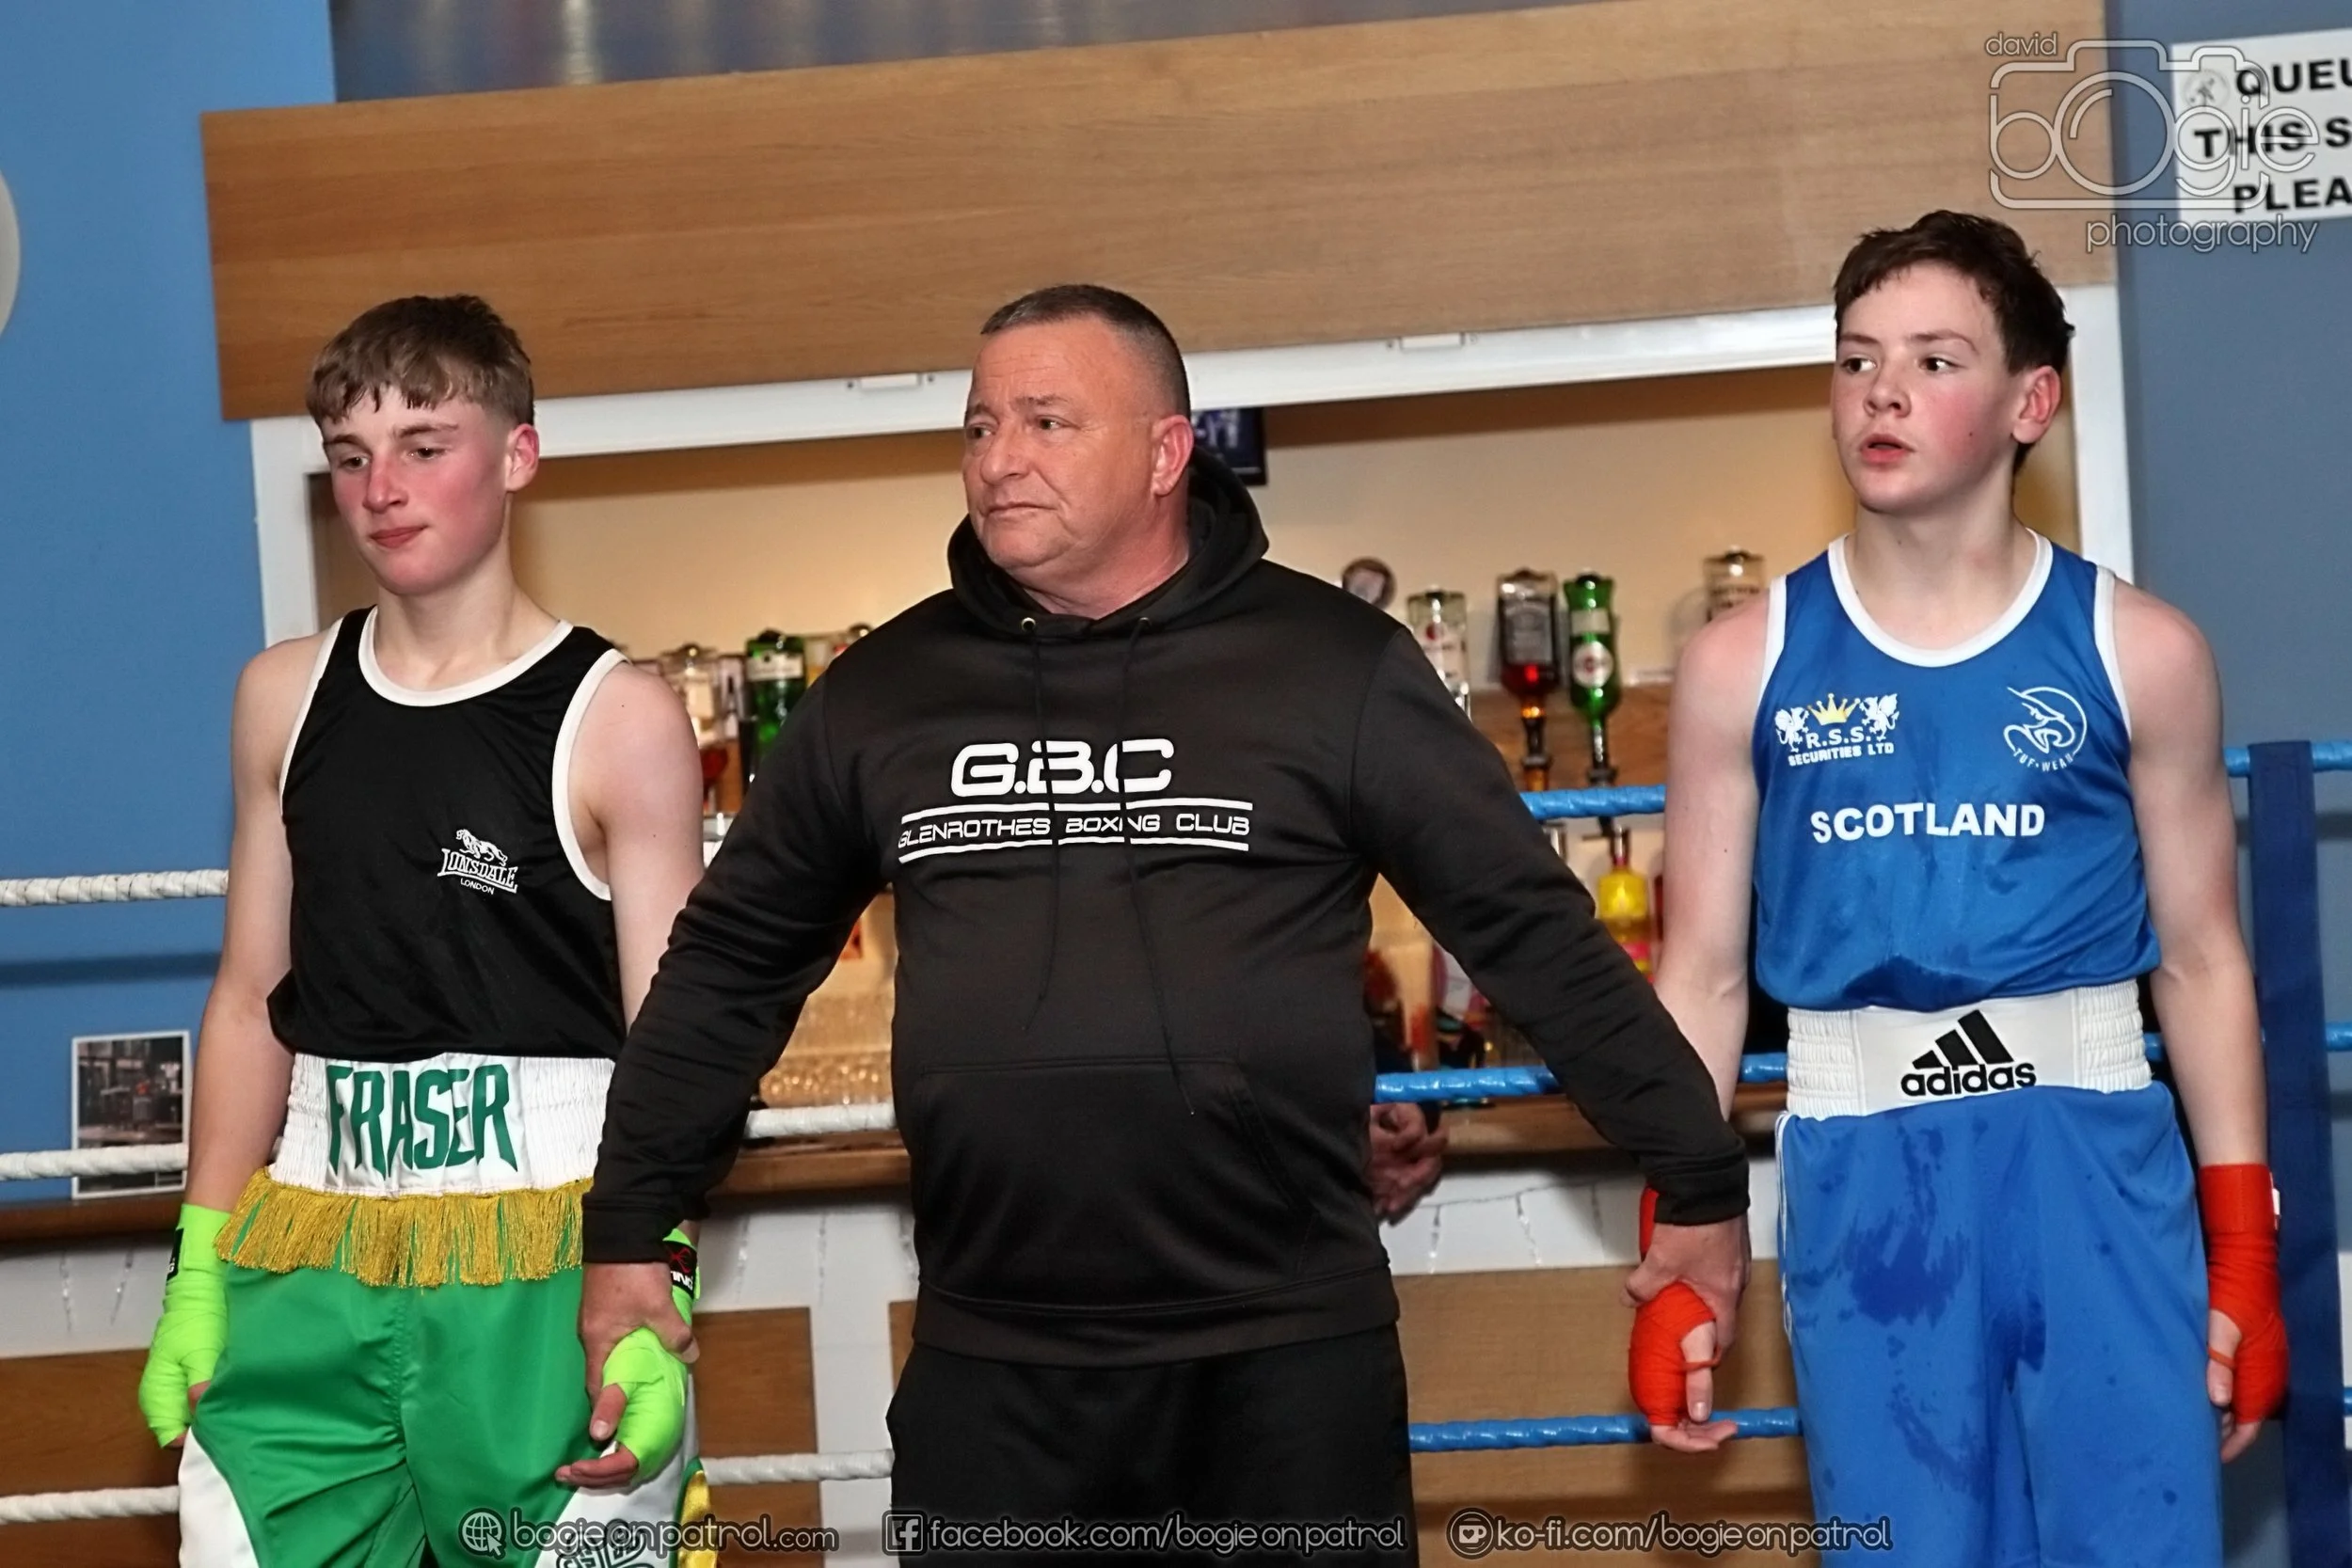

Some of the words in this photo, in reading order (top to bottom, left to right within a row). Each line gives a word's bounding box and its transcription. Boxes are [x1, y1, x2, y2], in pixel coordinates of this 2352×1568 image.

[2193, 120, 2305, 158] THIS
[1788, 744, 1863, 767] SECURITIES
[1867, 741, 1895, 755] LTD
[1805, 725, 1871, 750] R.S.S.
[898, 816, 1052, 848] GLENROTHES
[1064, 814, 1161, 834] BOXING
[1174, 812, 1250, 836] CLUB
[1810, 802, 2045, 844] SCOTLAND
[437, 847, 518, 894] LONSDALE
[460, 878, 495, 895] LONDON
[1900, 1063, 2037, 1097] adidas
[326, 1064, 518, 1181] FRASER
